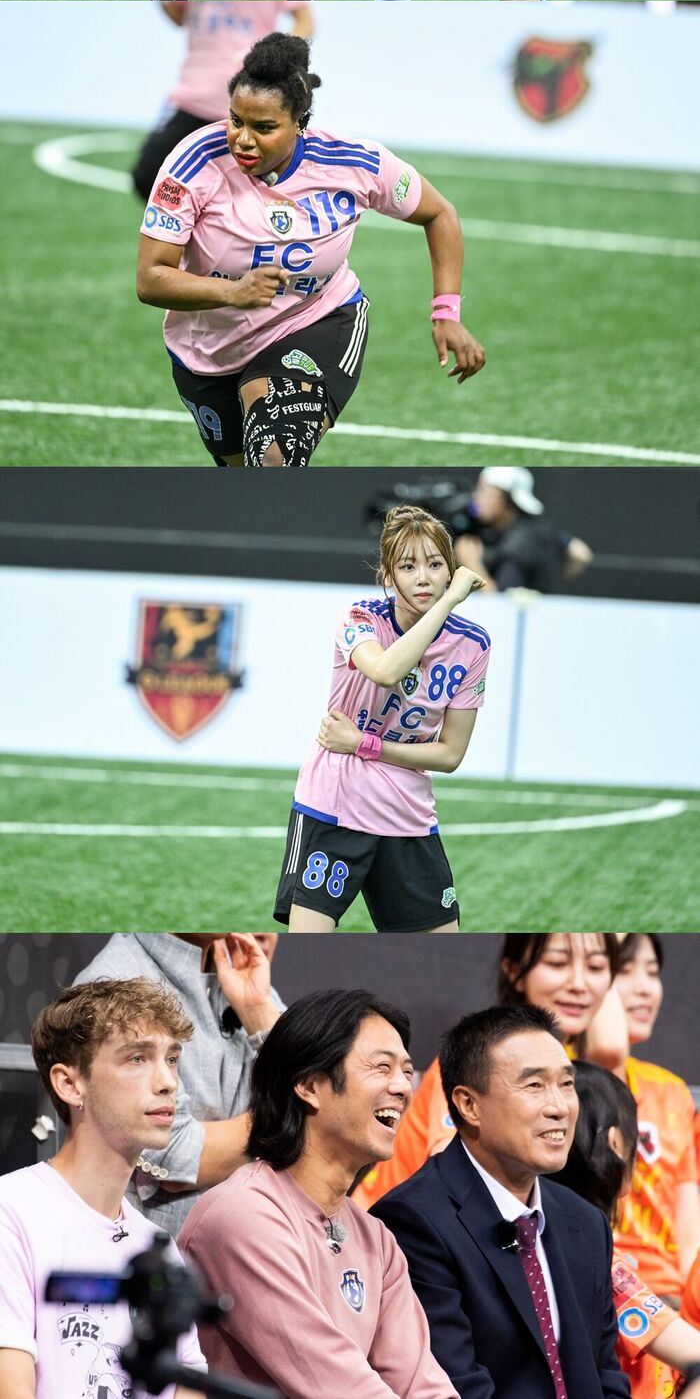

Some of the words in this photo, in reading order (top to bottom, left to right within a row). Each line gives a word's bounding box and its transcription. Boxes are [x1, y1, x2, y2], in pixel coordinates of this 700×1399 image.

[161, 181, 181, 196] PRISM
[158, 215, 182, 233] SBS
[296, 189, 357, 236] 119
[250, 242, 314, 273] FC
[427, 663, 467, 702] 88
[381, 692, 426, 730] FC
[302, 851, 349, 898] 88
[61, 1315, 100, 1341] JAZZ
